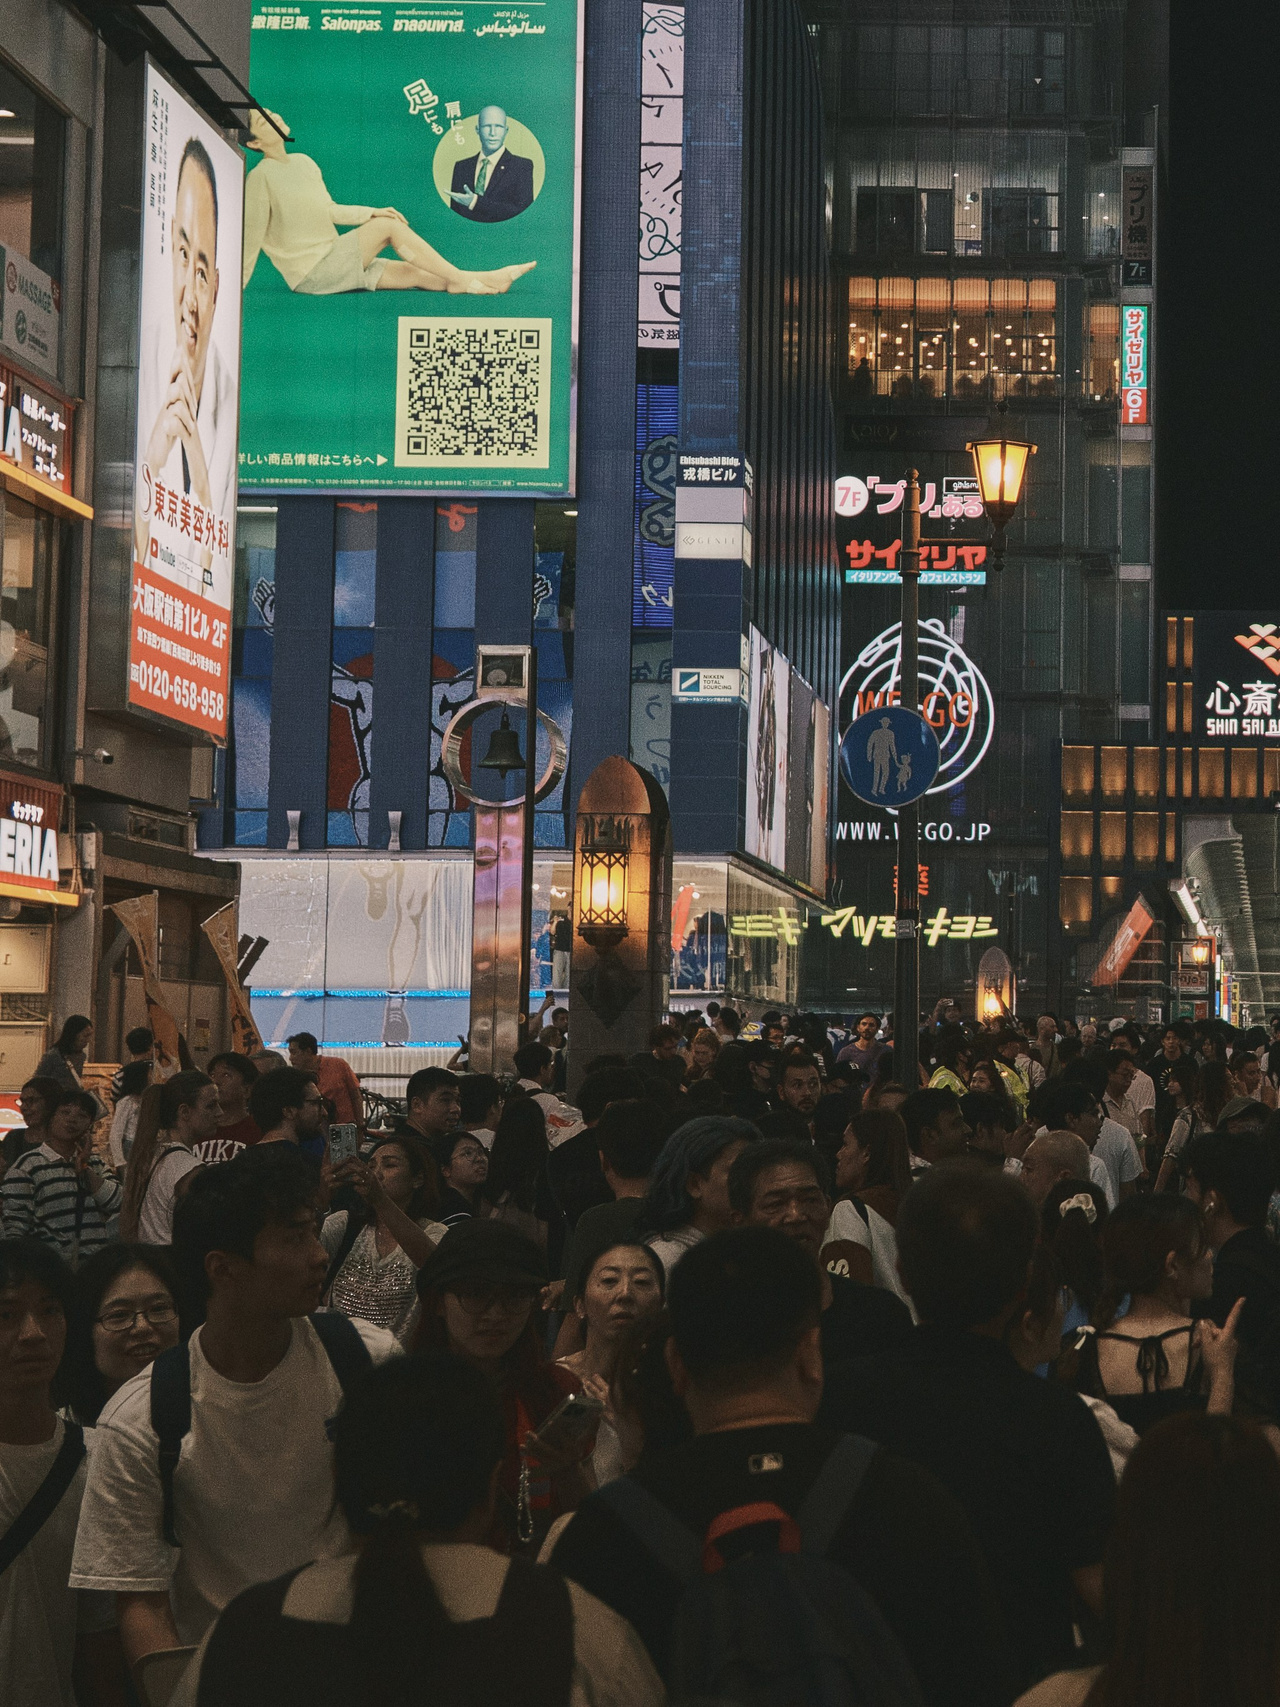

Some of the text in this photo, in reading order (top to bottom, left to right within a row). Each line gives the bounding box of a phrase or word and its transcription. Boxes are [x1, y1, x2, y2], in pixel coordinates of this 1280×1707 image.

[1126, 309, 1144, 387] サイゼリヤ
[680, 456, 741, 467] Ebisubashi Bldg.
[683, 467, 737, 481] 戎橋ビル
[837, 486, 861, 508] 7F
[154, 480, 230, 558] 東京美容外科
[133, 577, 228, 649] 大阪駅前第1ビル 2F
[139, 659, 224, 721] 0120-658-958
[1206, 718, 1238, 736] SHIN
[1242, 718, 1264, 736] SAI
[836, 821, 991, 841] WWW.GO.JP
[821, 905, 998, 946] マツモキヨシ
